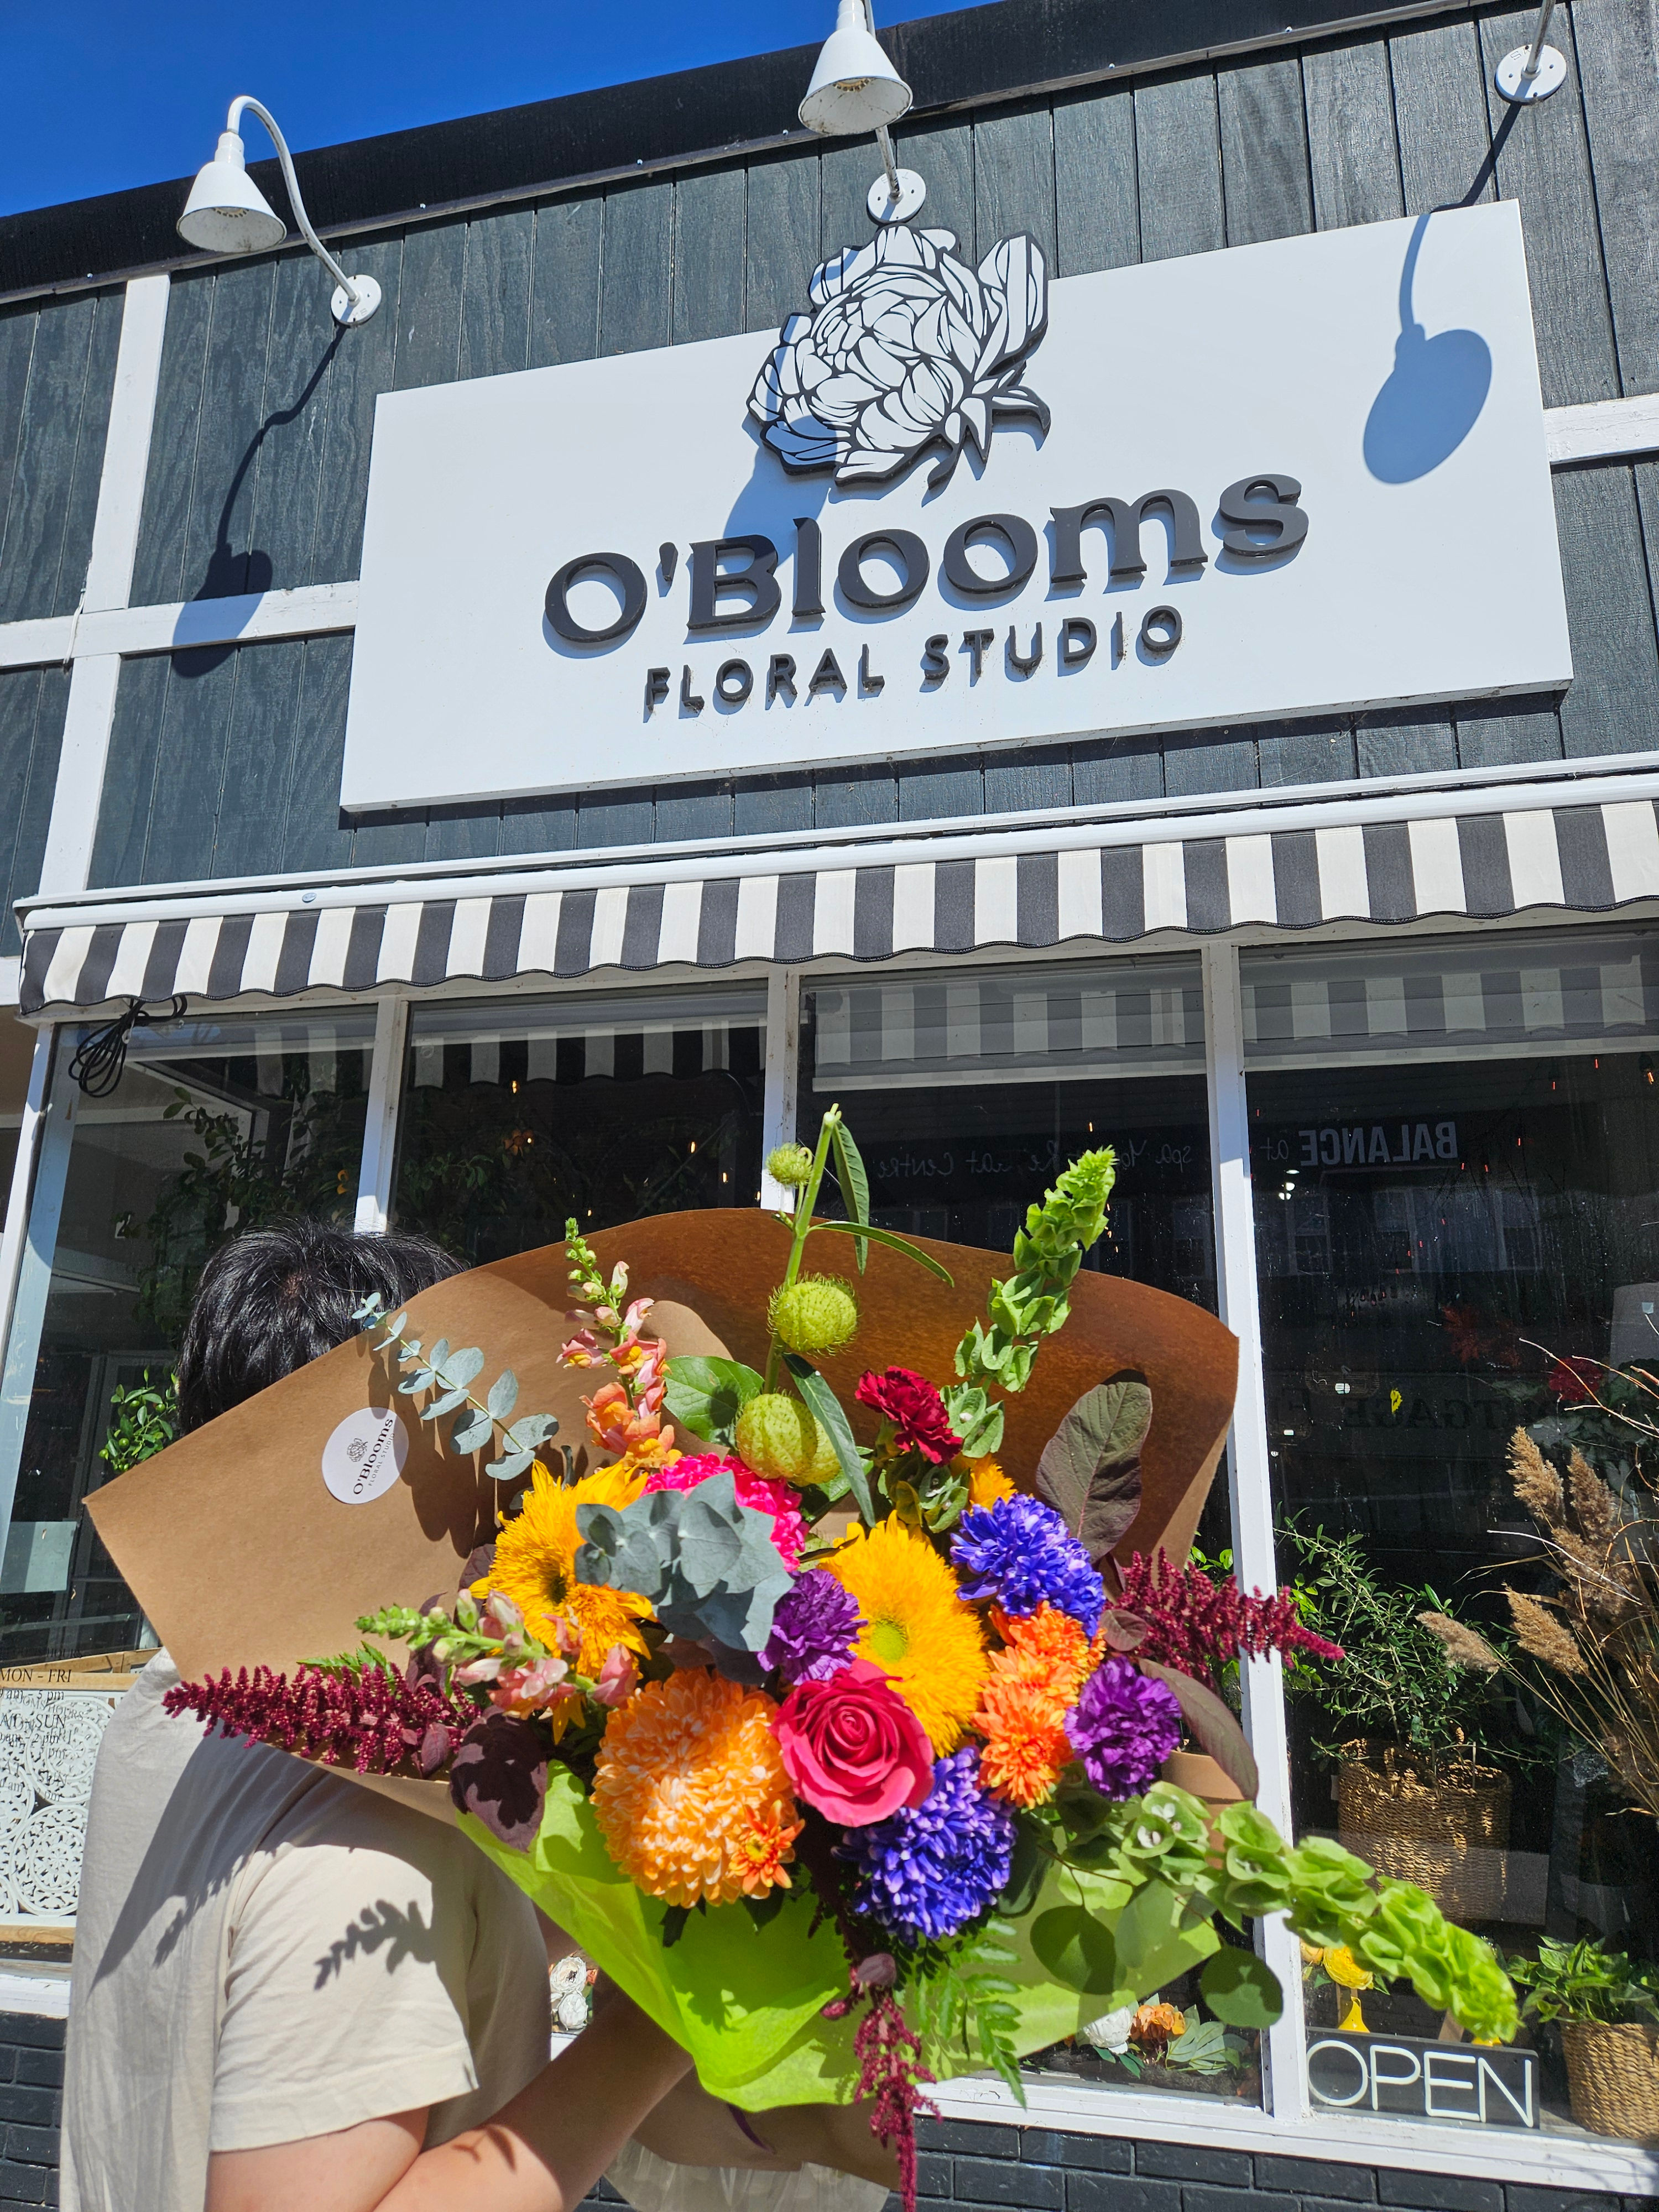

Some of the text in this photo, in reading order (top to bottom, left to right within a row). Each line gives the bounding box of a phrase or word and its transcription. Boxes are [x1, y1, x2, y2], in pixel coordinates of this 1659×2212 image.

[545, 474, 1309, 643] O'Blooms
[646, 605, 1182, 713] FLORAL STUDIO
[353, 1419, 393, 1495] O'Blooms
[368, 1433, 395, 1486] FLORAL STUDIO
[0, 1668, 33, 1682] MON
[48, 1669, 72, 1683] FRI
[36, 1689, 44, 1700] 5
[46, 1691, 64, 1704] pm
[36, 1714, 67, 1729] SUN
[1306, 2039, 1533, 2128] OPEN
